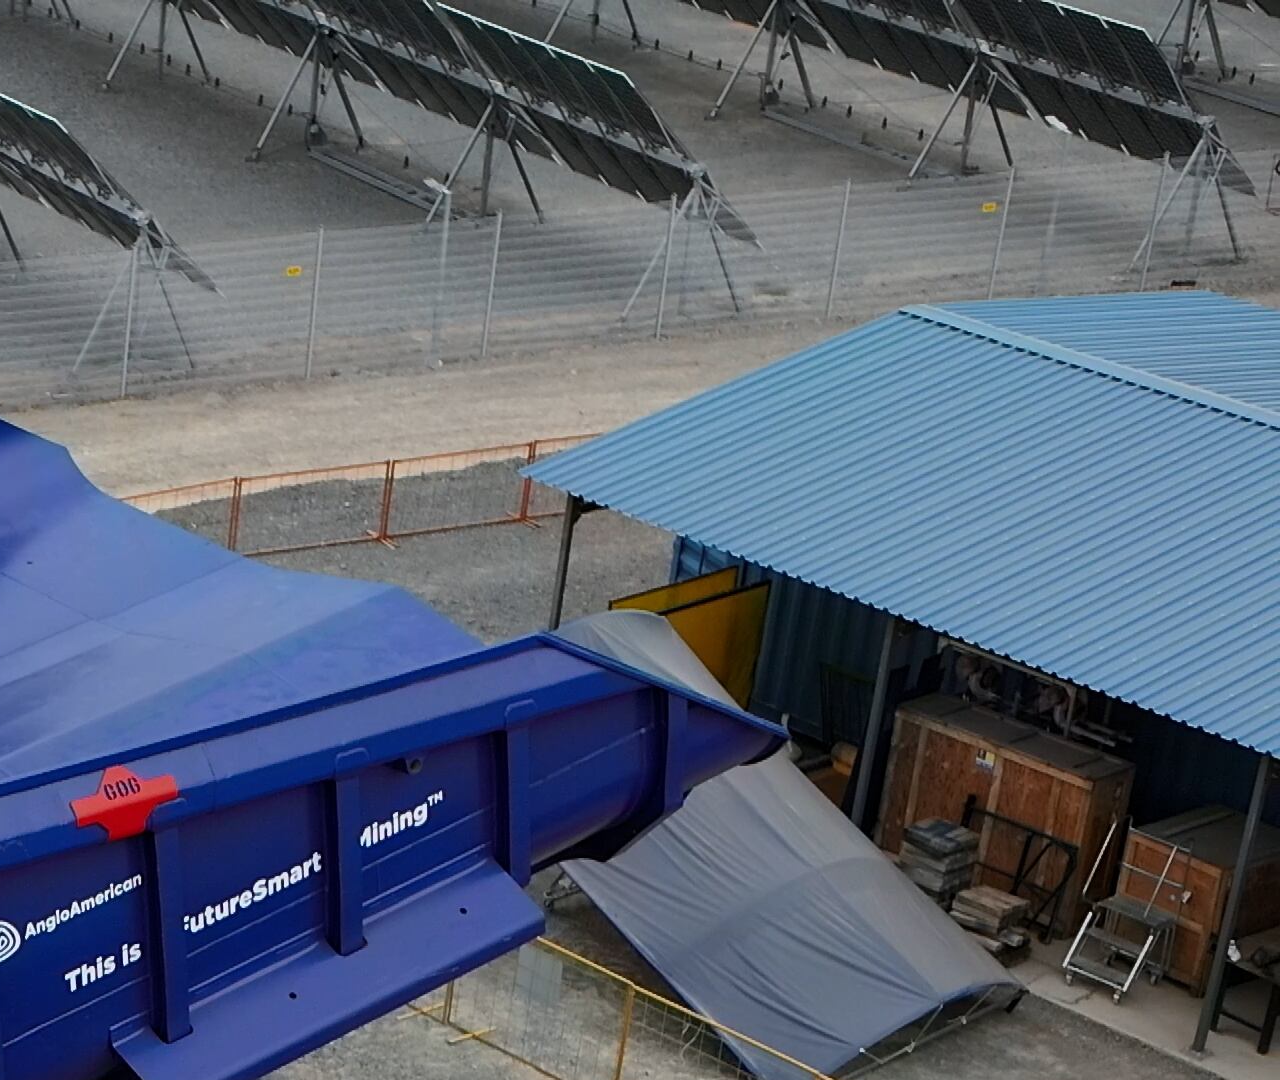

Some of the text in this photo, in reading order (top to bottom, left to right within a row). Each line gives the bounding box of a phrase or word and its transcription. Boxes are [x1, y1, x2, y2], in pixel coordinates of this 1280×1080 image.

[25, 874, 142, 940] AngloAmerican
[64, 956, 116, 992] This
[122, 943, 141, 967] is
